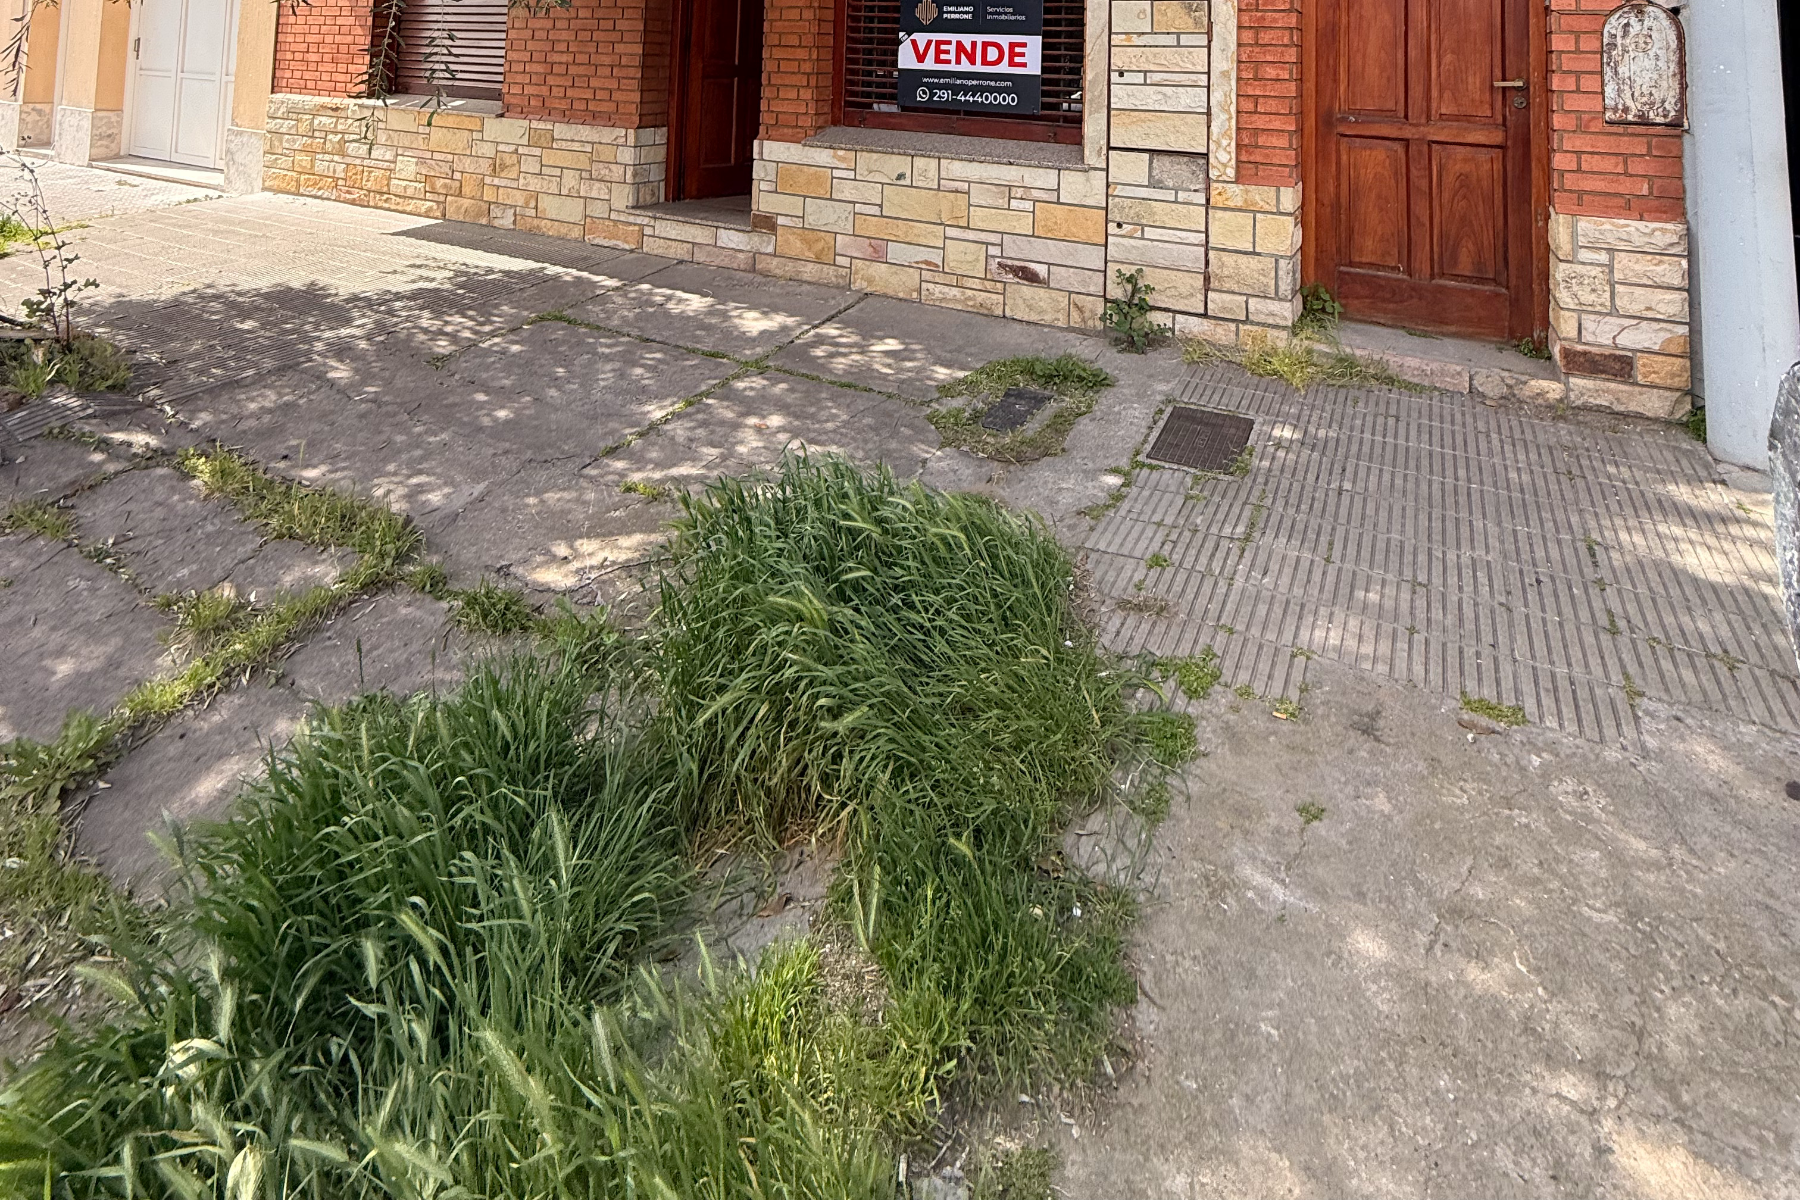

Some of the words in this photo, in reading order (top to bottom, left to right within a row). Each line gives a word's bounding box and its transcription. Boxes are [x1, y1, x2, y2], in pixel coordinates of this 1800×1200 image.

[986, 13, 1026, 21] Inmobiliarios
[910, 38, 1028, 68] VENDE
[922, 76, 1012, 87] www.emilianoperrone.com
[932, 89, 1018, 106] 291-4440000
